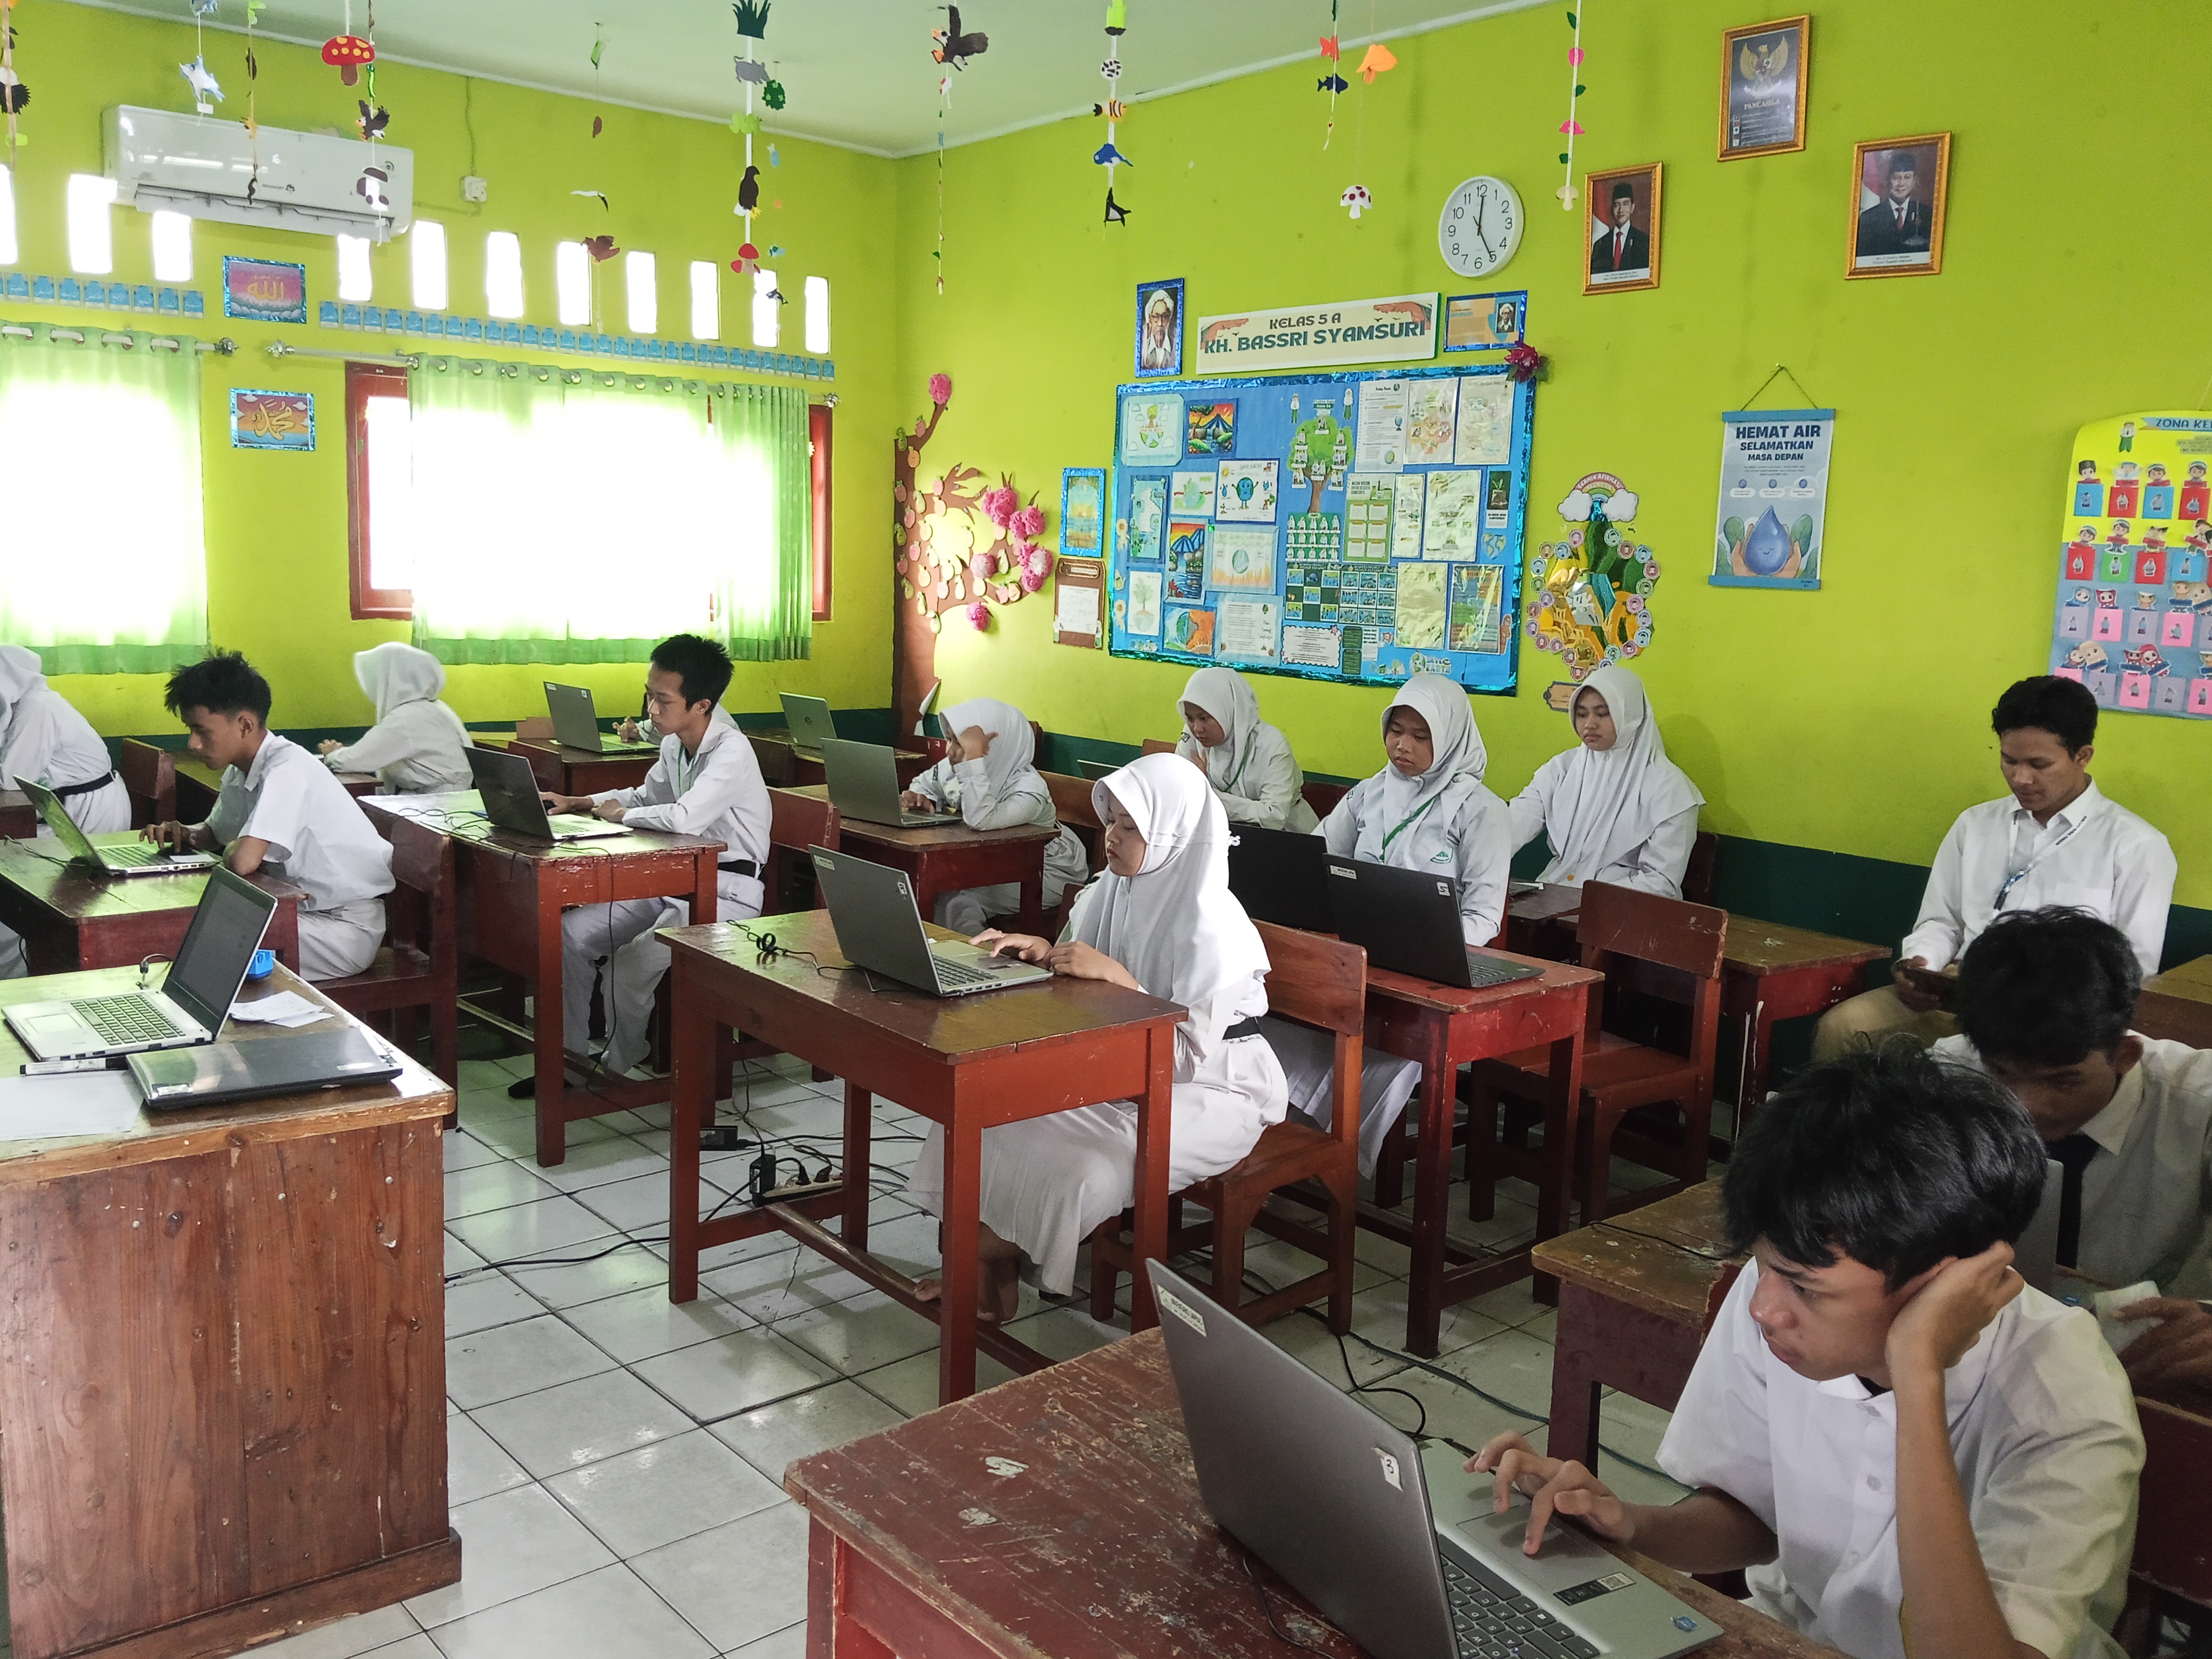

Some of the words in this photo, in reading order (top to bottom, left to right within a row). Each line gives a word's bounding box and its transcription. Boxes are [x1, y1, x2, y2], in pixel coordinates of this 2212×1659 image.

[1476, 184, 1487, 197] 12
[1494, 189, 1498, 201] 1
[1464, 193, 1471, 205] 11
[1501, 200, 1509, 213] 2
[1453, 207, 1464, 219] 10
[1505, 217, 1513, 230] 3
[1448, 225, 1456, 237] 9
[1452, 243, 1460, 255] 8
[1499, 237, 1507, 249] 4
[1461, 254, 1468, 265] 7
[1489, 251, 1496, 262] 5
[1474, 257, 1482, 269] 6
[1270, 315, 1315, 329] KELAS
[1318, 314, 1328, 325] 5
[1331, 313, 1341, 323] A
[1204, 339, 1232, 354] KH.
[1237, 331, 1309, 351] BASSRI
[1313, 321, 1426, 345] SYAMSURI
[2156, 419, 2189, 428] ZONA
[1736, 426, 1790, 439] HEMAT
[1793, 424, 1821, 438] AIR
[1739, 440, 1814, 451] SELAMATKAN
[1748, 453, 1772, 462] MASA
[1775, 453, 1804, 461] DEPAN
[1386, 1459, 1394, 1474] 3
